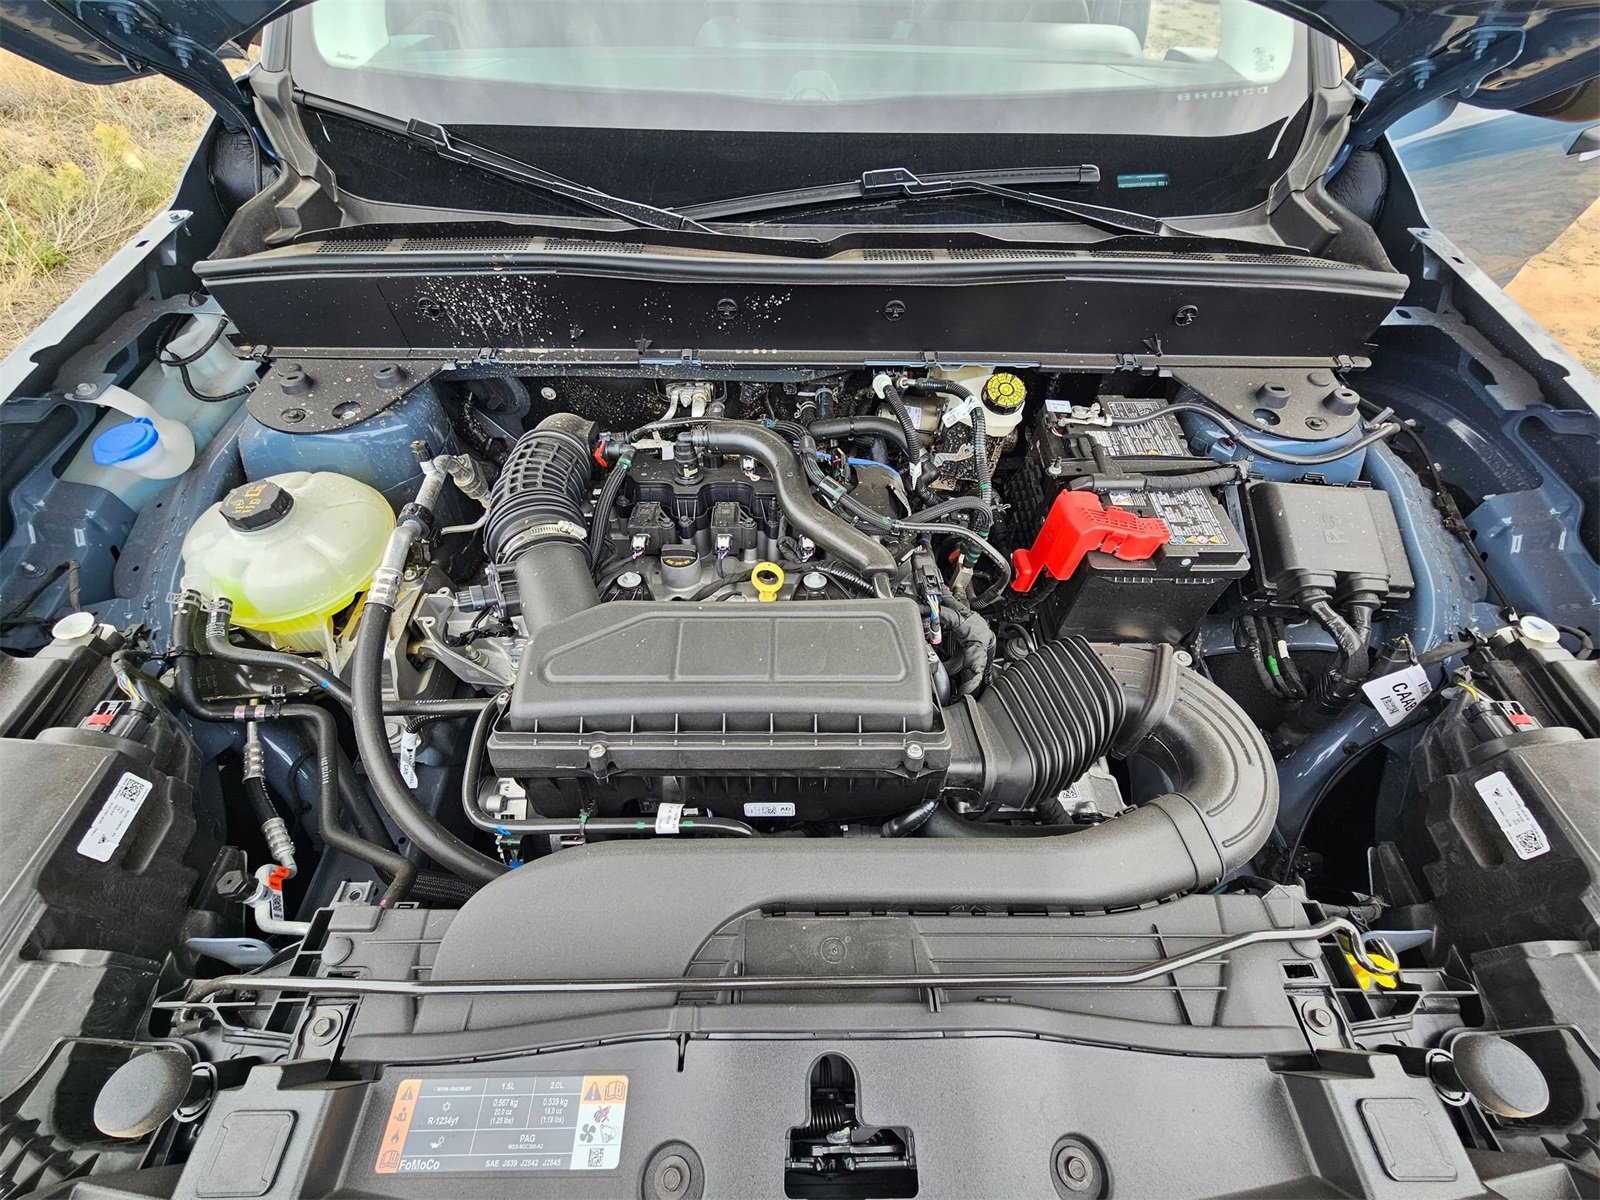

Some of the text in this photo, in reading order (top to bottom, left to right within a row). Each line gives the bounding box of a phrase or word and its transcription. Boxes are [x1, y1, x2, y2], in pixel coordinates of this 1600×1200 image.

[1176, 86, 1269, 101] BRONCO
[509, 1098, 518, 1108] kg
[559, 1097, 568, 1108] kg
[427, 1116, 460, 1127] R-1234yf
[519, 1134, 536, 1143] PAG
[399, 1159, 441, 1171] FoMoCo
[485, 1160, 500, 1168] SAE
